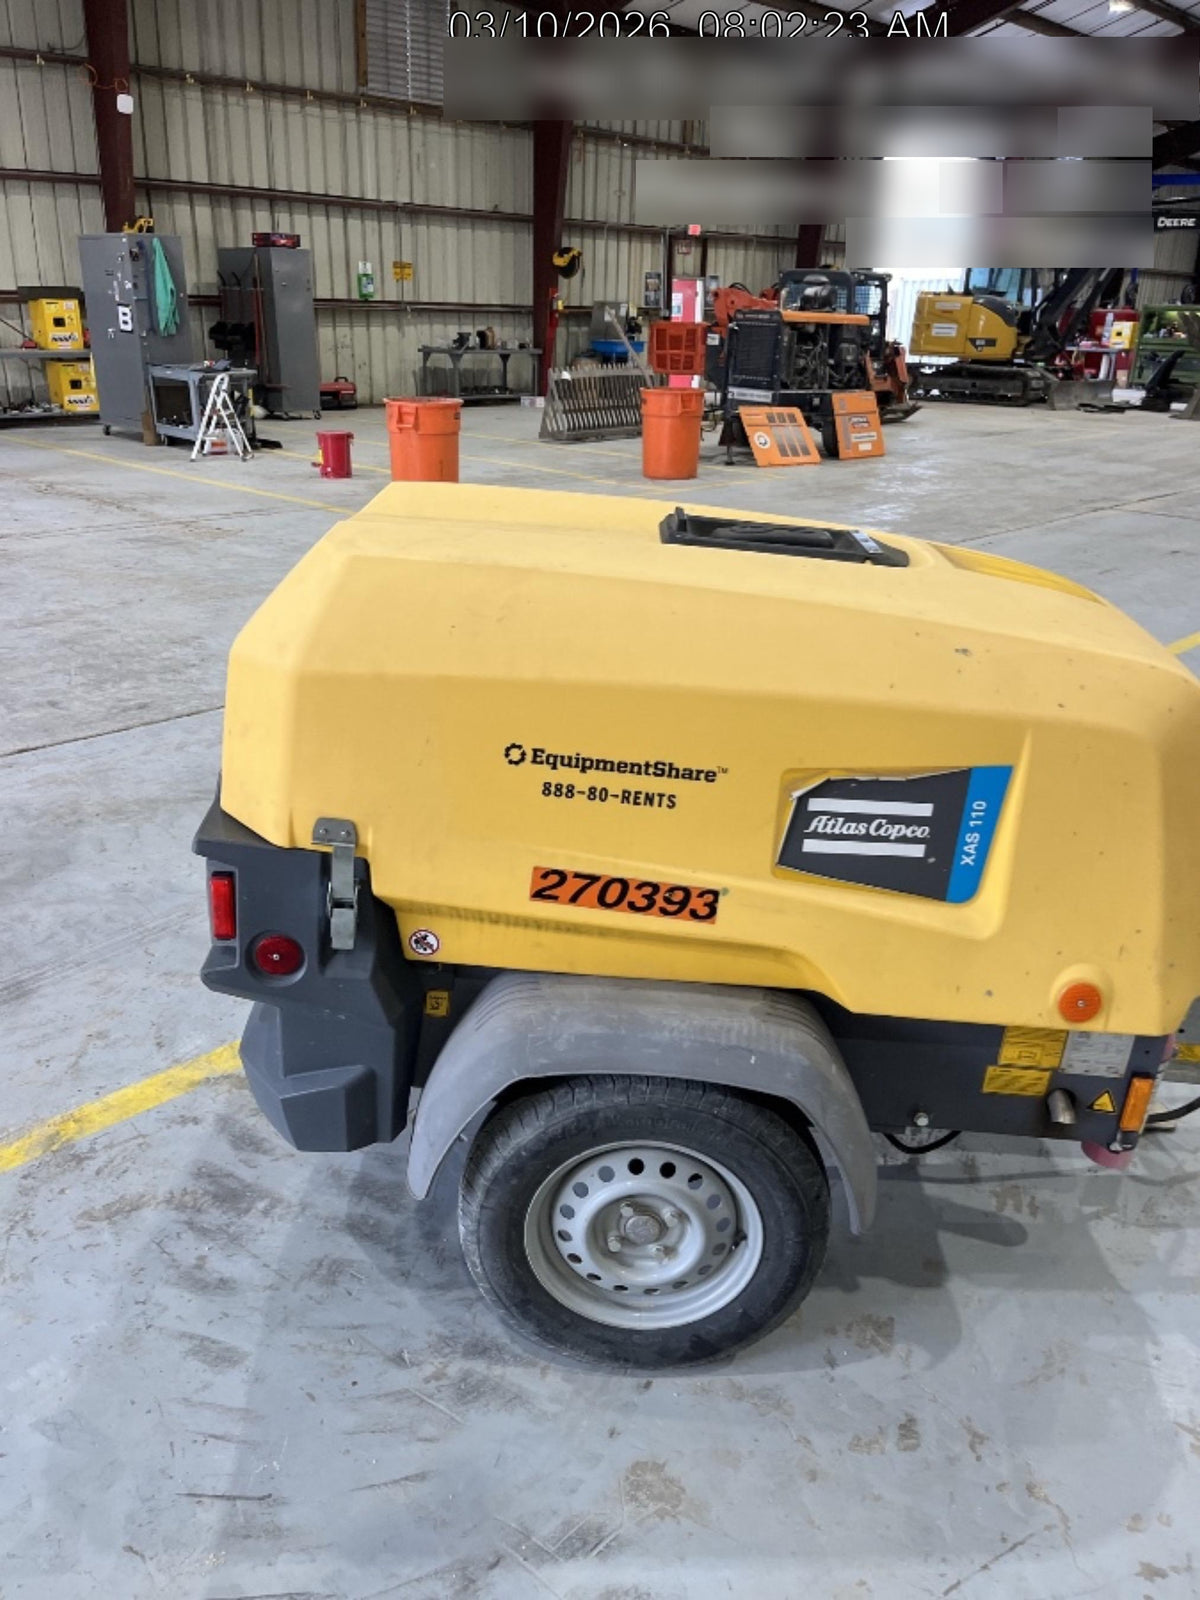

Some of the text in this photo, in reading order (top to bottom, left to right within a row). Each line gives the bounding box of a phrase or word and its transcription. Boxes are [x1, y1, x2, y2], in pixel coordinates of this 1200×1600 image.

[1157, 216, 1197, 228] DEERE
[118, 306, 133, 331] B
[541, 782, 677, 810] 888-80-RENTS
[803, 815, 930, 840] Atlas Copco
[960, 800, 987, 867] XAS 110
[531, 868, 720, 921] 270393
